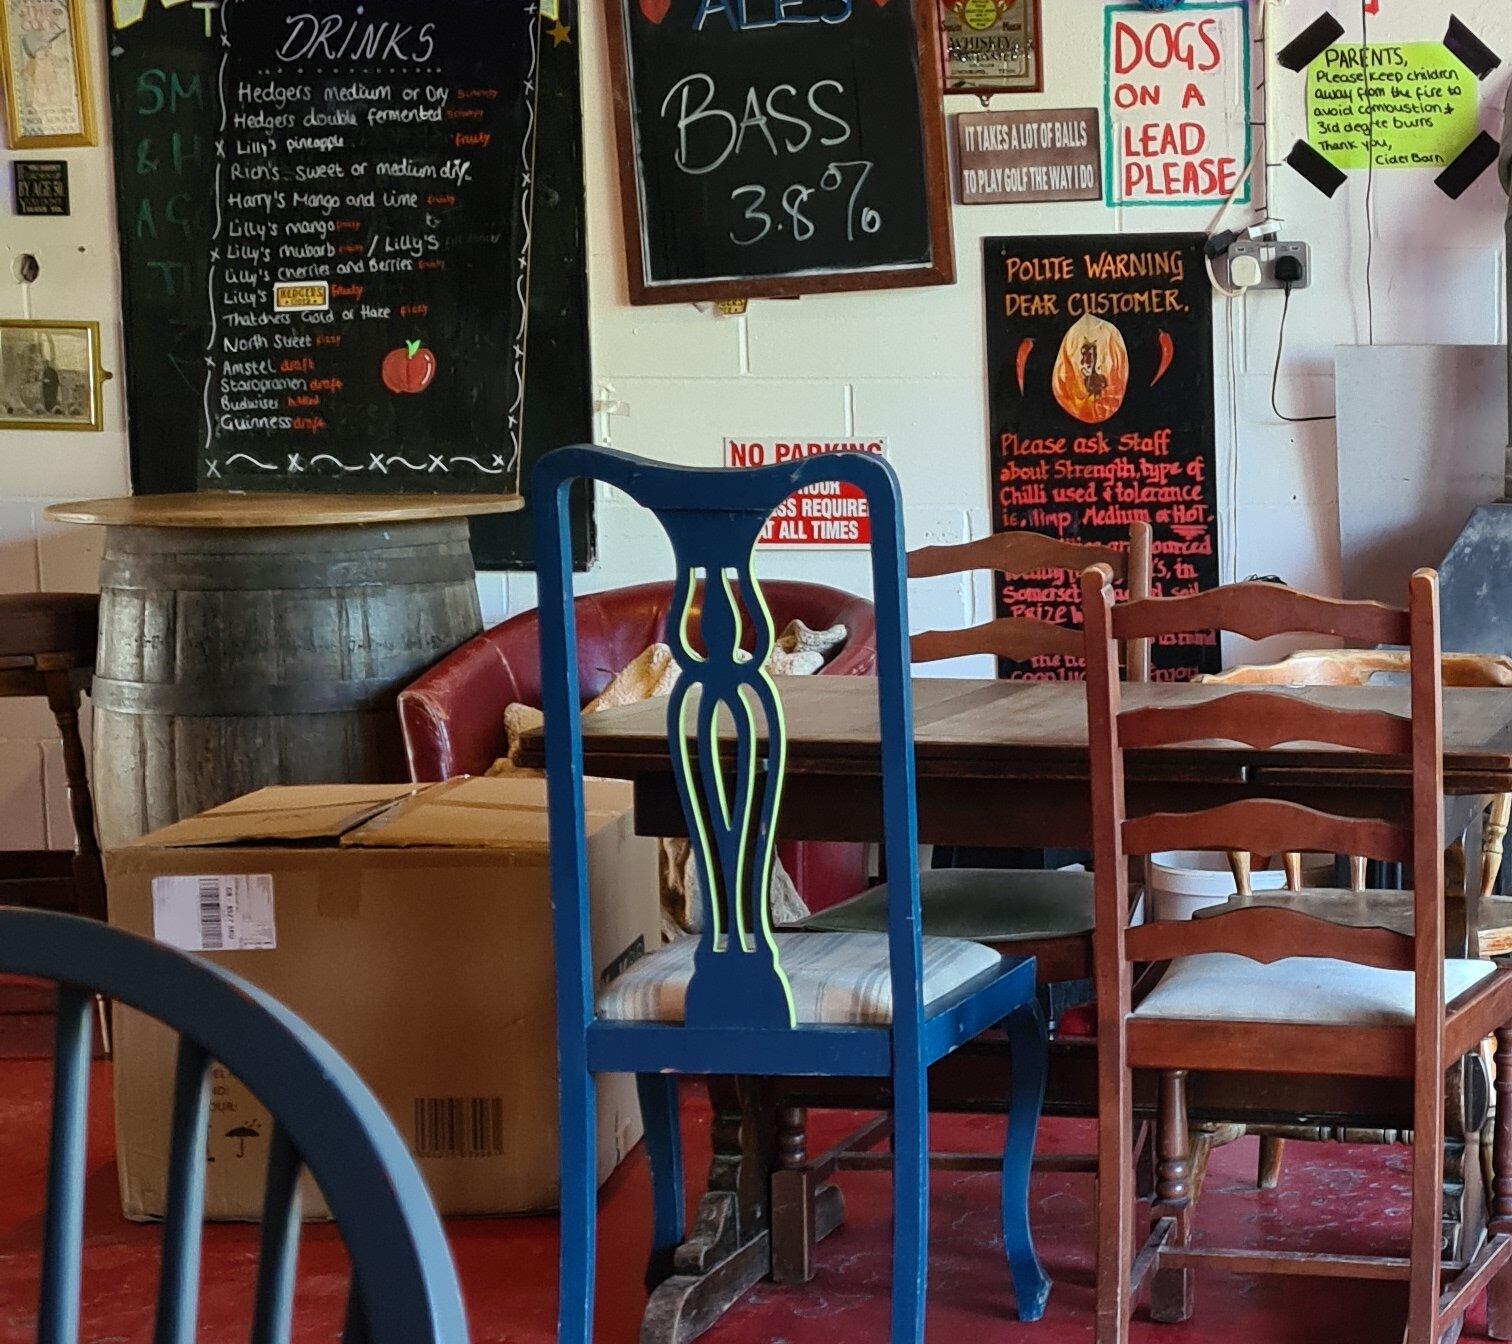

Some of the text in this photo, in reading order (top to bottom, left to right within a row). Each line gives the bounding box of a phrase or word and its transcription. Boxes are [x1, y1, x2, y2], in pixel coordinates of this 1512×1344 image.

[275, 5, 437, 63] DRINKS
[1114, 18, 1221, 75] DOGS
[1324, 48, 1409, 69] PARENTS,
[1316, 69, 1364, 84] Please
[1406, 68, 1459, 82] children
[237, 80, 313, 105] Hedgers
[323, 82, 392, 102] medium
[401, 87, 420, 102] or
[1113, 82, 1207, 110] ON A
[1314, 88, 1353, 104] away
[1390, 85, 1413, 99] the
[1415, 85, 1443, 102] fire
[1447, 85, 1462, 98] to
[233, 112, 296, 135] Hedgers
[302, 110, 358, 127] double
[367, 106, 443, 127] fermented
[1313, 102, 1443, 118] avoid combustion
[660, 72, 851, 174] BASS
[1316, 119, 1341, 135] 3rd
[1392, 115, 1434, 129] burns
[285, 136, 345, 157] pineapple
[964, 119, 1089, 152] IT TAKES A LOT OF BALLS
[1124, 122, 1207, 158] LEAD
[1317, 140, 1358, 152] Thank
[1375, 152, 1445, 166] Cider Barn
[230, 159, 437, 183] Rich's sweet or medium
[963, 163, 1095, 194] TO PLAY GOLF THE WAY I DO
[1124, 156, 1238, 197] PLEASE
[292, 192, 376, 215] Mango and
[729, 160, 882, 246] 3.8%
[285, 218, 336, 240] mango
[278, 240, 337, 258] rhubarb
[336, 258, 414, 274] and Berries
[1005, 249, 1185, 284] POLITE WARNING
[1005, 288, 1190, 318] DEAR CUSTOMER.
[300, 310, 335, 328] Gold
[222, 335, 313, 354] North Street
[222, 359, 277, 375] Amstel
[220, 414, 293, 432] Guinness
[1000, 428, 1172, 457] Please ask Staff
[731, 442, 765, 468] NO
[1000, 456, 1205, 485] about type of
[1000, 481, 1204, 507] Chilli used tolerance
[1082, 506, 1152, 527] Medium
[778, 520, 859, 541] ALL TIMES
[1002, 585, 1082, 605] Somerset
